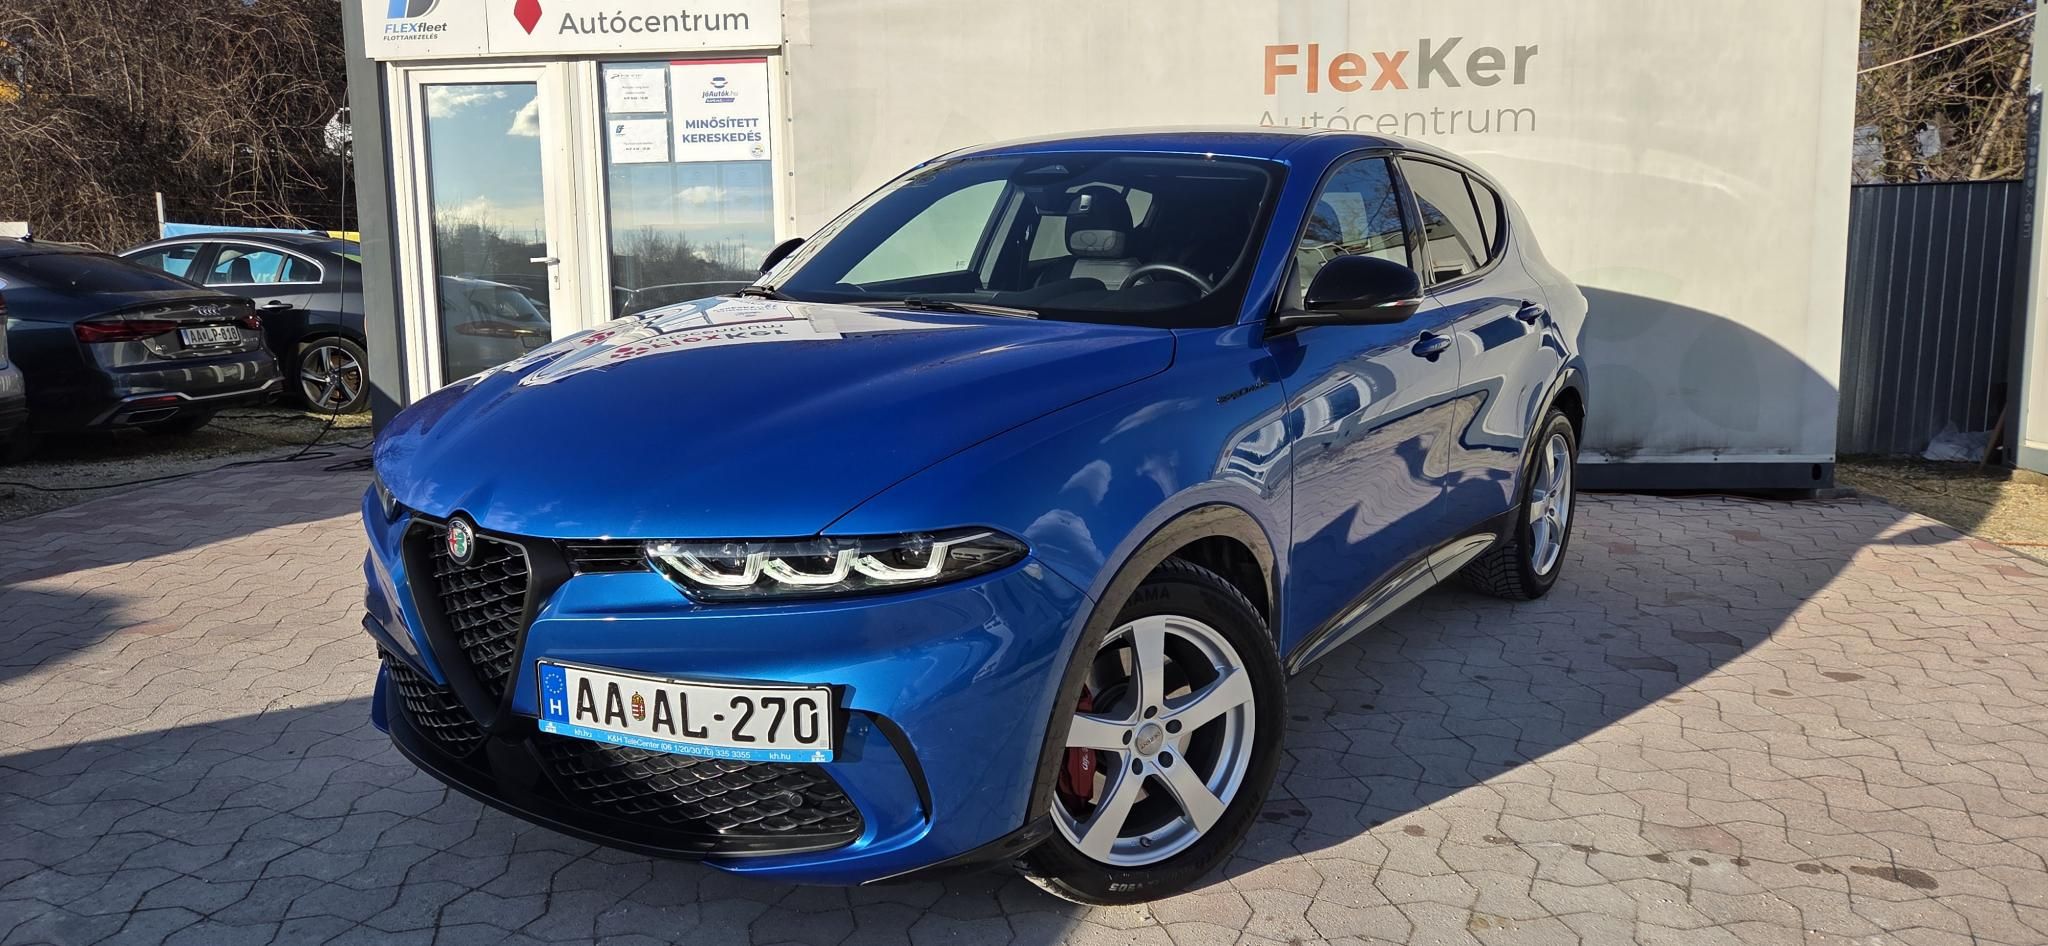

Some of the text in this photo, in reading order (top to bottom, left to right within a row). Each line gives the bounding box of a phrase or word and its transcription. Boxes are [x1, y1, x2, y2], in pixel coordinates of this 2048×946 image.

[384, 22, 448, 34] FLEXfleet
[558, 9, 750, 35] Autócentrum
[383, 33, 438, 41] FLOTTAKEZELÉS
[1263, 36, 1539, 96] FlexKer
[685, 115, 759, 129] MINŐSÍTETT
[682, 130, 762, 143] KERESKEDÉS
[190, 330, 204, 343] AA
[205, 327, 238, 341] LP-818
[549, 698, 563, 716] H
[575, 677, 819, 744] AA AL-270
[574, 728, 593, 738] kh.hu
[607, 734, 623, 743] K&H
[623, 737, 660, 750] TeleCenter
[731, 751, 751, 759] 3355
[769, 752, 791, 760] kh.hu
